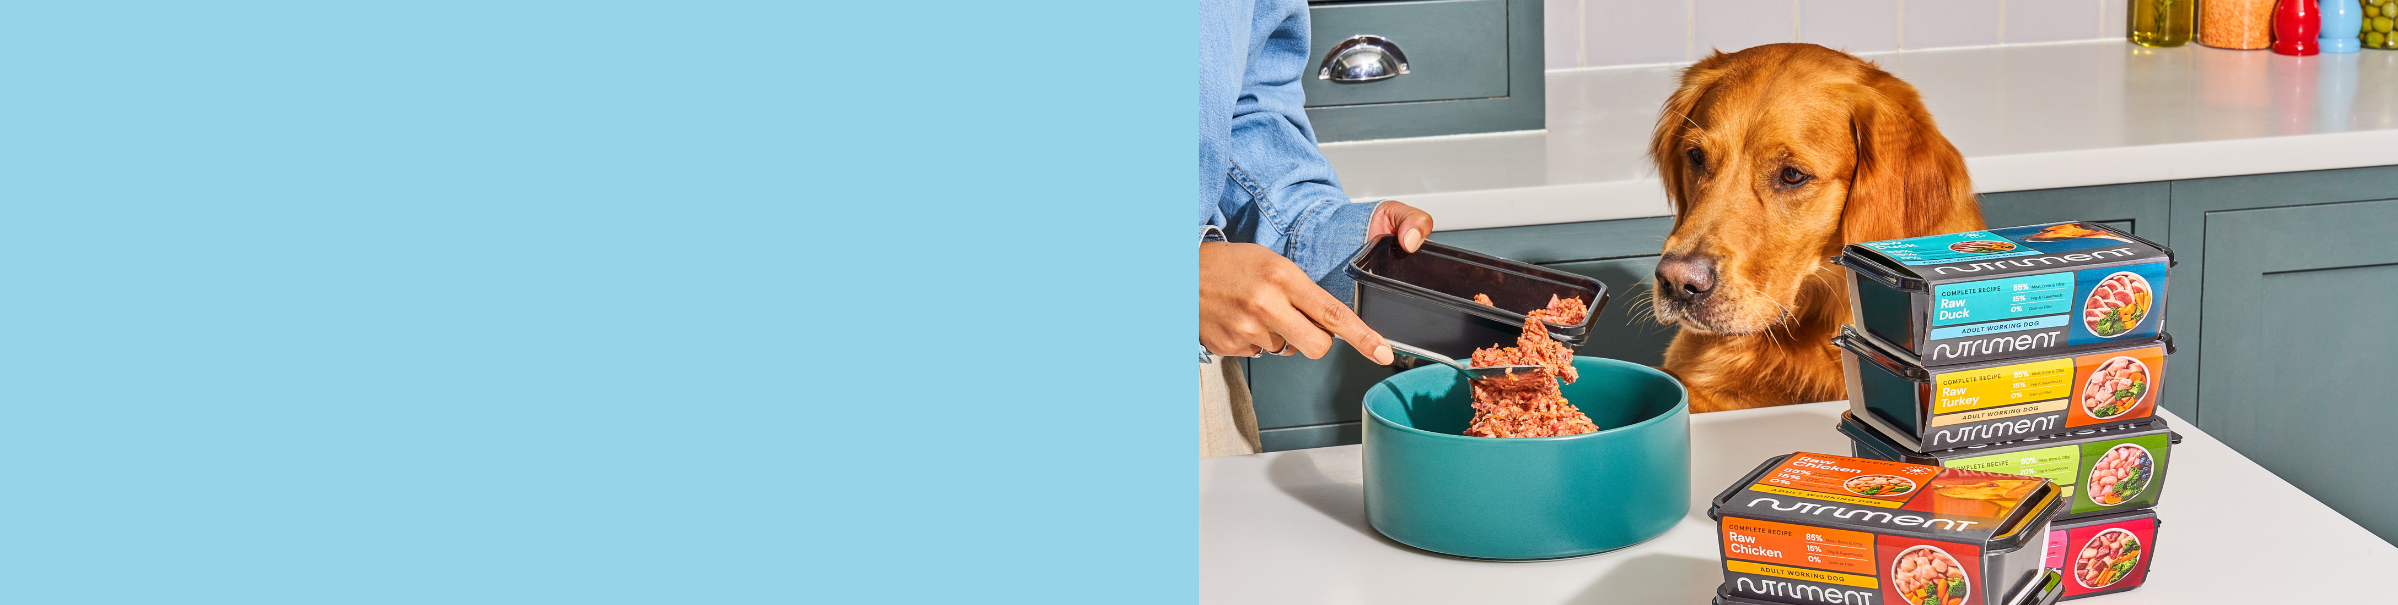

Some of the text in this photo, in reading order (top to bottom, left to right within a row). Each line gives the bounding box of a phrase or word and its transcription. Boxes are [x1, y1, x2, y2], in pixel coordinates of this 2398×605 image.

[1942, 288, 1976, 297] COMPLETE
[1941, 299, 1966, 309] Raw
[1940, 308, 1970, 320] Duck
[1987, 323, 2021, 331] WORKING
[2013, 370, 2029, 378] 85%
[1943, 377, 1977, 385] COMPLETE
[1942, 387, 1967, 397] Raw
[1941, 396, 1980, 408] Turkey
[1962, 412, 1985, 420] ADULT
[1987, 409, 2021, 417] WORKING
[1799, 456, 1835, 465] Raw
[1793, 461, 1862, 474] Chicken
[1729, 524, 1766, 534] COMPLETE
[1729, 532, 1756, 544] Raw
[1806, 533, 1823, 541] 85%
[1730, 543, 1782, 558] Chicken
[1760, 567, 1784, 575] ADULT
[1786, 570, 1824, 580] WORKING
